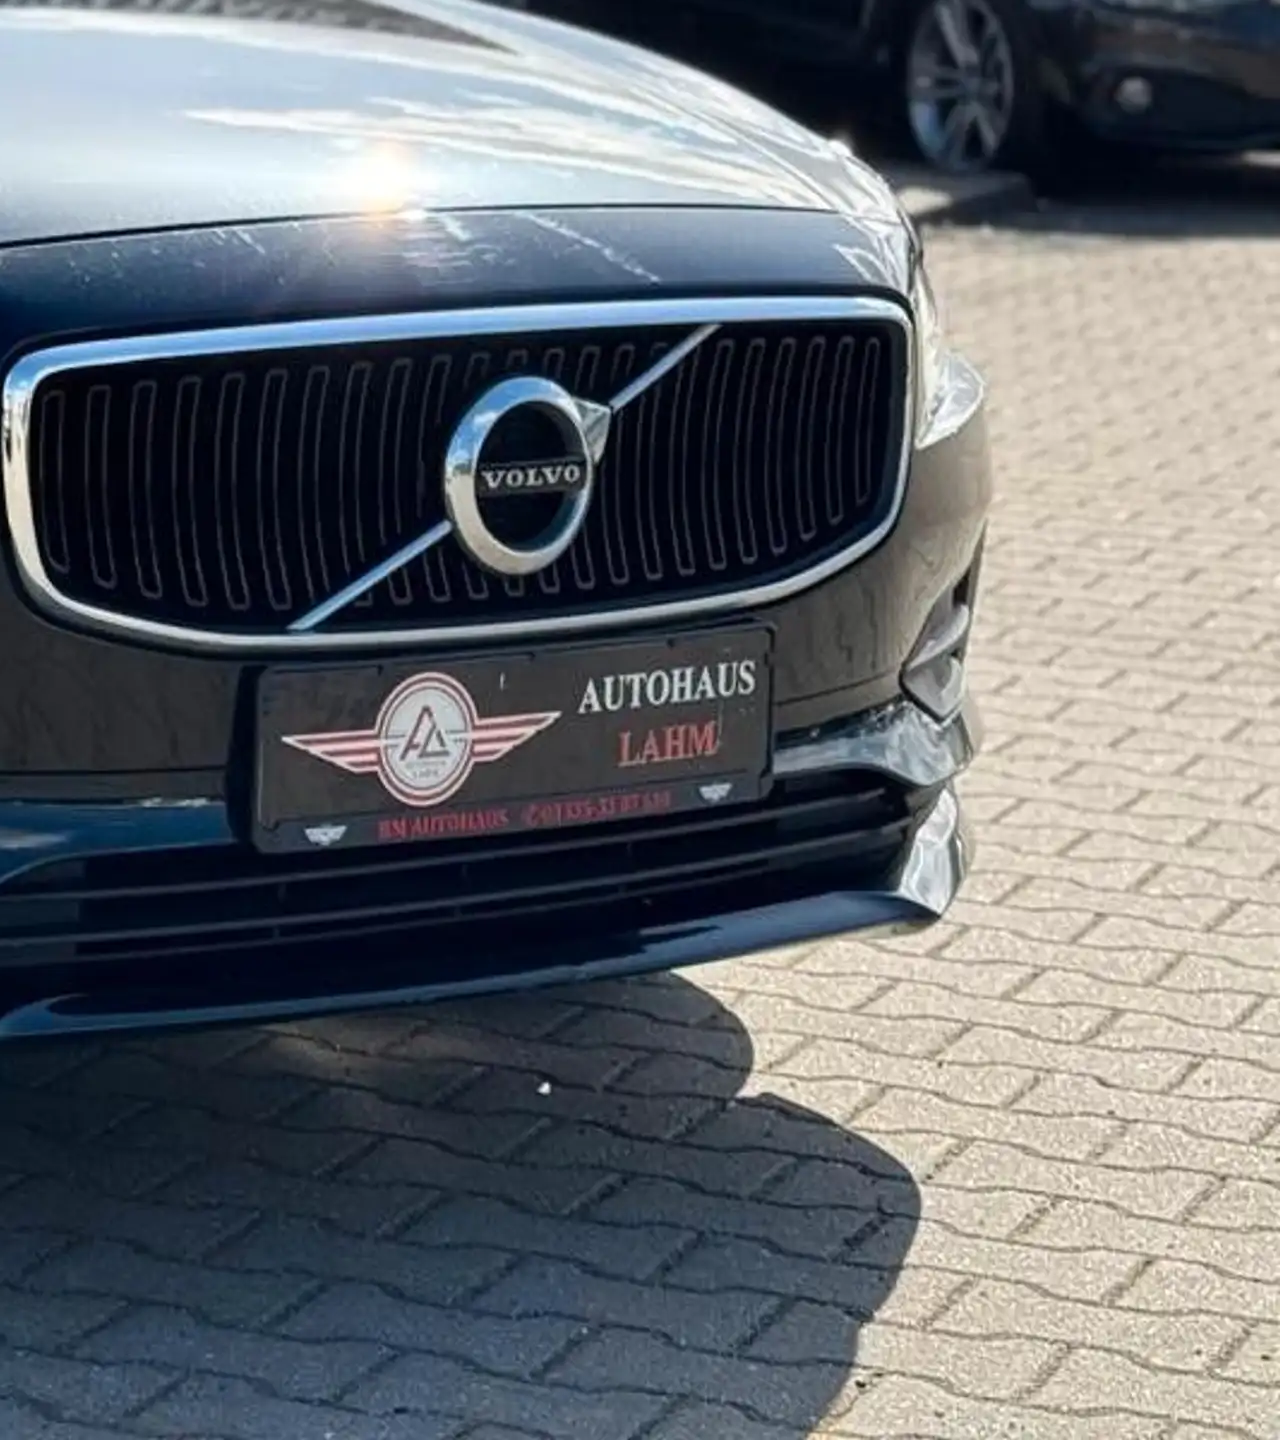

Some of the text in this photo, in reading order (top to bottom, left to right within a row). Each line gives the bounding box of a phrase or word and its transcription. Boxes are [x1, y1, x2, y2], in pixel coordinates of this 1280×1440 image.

[480, 464, 581, 490] VOLVO
[577, 659, 757, 714] AUTOHAUS
[617, 718, 720, 768] LAHM
